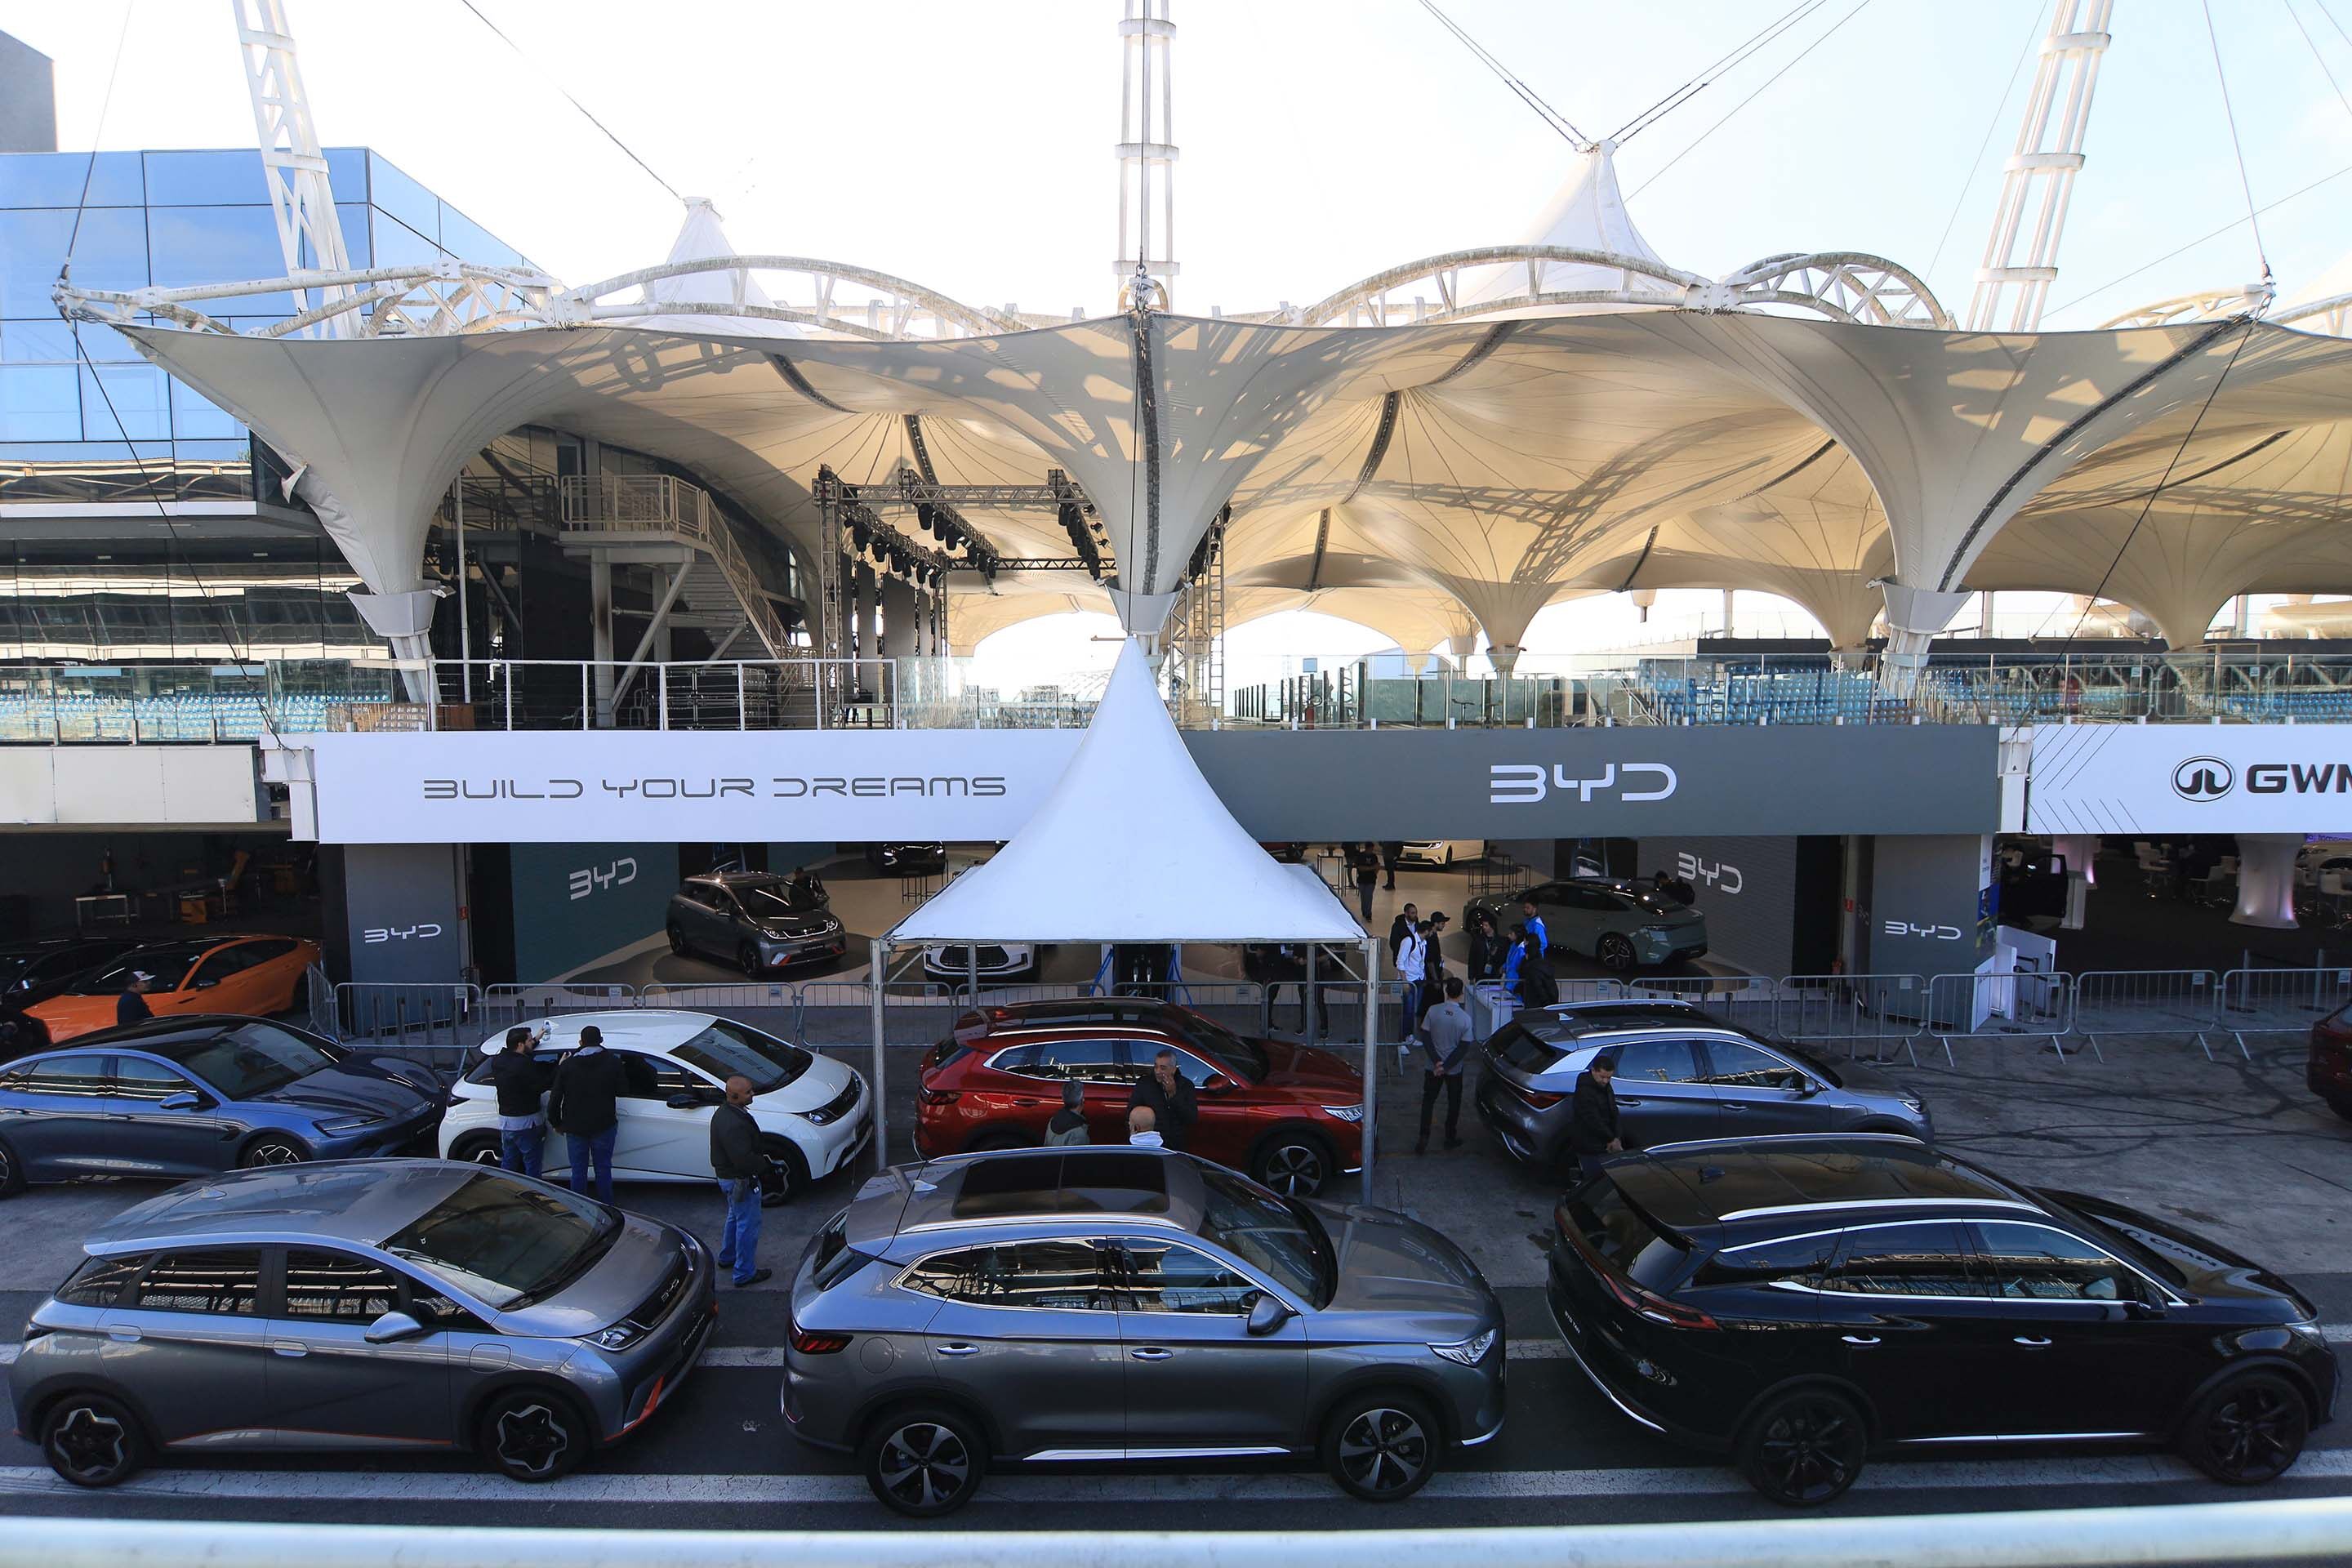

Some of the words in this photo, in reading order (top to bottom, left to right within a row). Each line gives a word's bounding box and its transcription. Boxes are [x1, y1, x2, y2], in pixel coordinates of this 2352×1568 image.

[424, 777, 583, 800] BUILD
[602, 777, 755, 800] YOUR
[773, 777, 1007, 799] DREAMS
[1490, 763, 1677, 804] BYD
[569, 857, 637, 901] BYD
[1677, 852, 1743, 894] BYD
[364, 924, 442, 944] BYD
[1885, 920, 1962, 940] BYD
